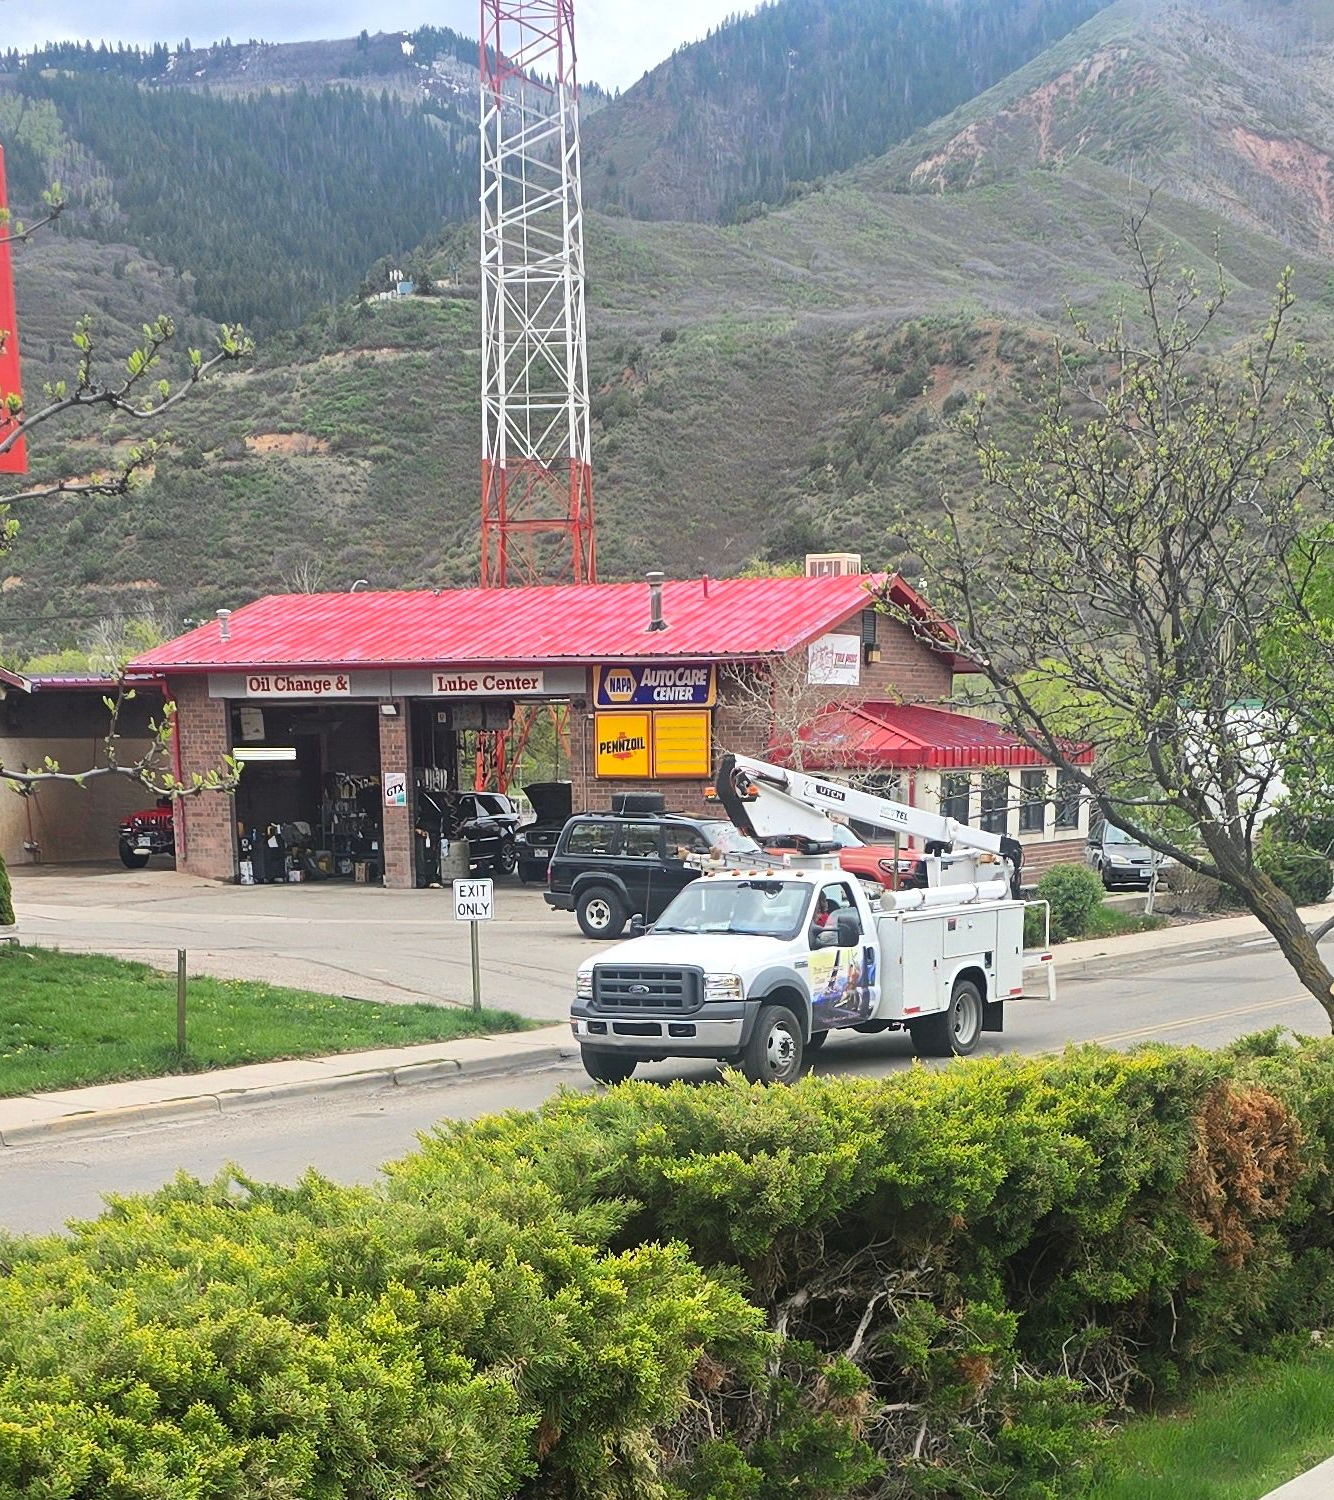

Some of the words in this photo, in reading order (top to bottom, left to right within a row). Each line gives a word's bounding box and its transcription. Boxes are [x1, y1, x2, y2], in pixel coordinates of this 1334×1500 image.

[249, 677, 270, 692] Oil
[274, 677, 331, 694] Change
[336, 675, 347, 690] &
[437, 676, 478, 691] Lube
[483, 675, 538, 690] Center
[610, 677, 632, 692] NAPA
[653, 687, 693, 701] CENTER
[600, 737, 645, 755] PENNZOIL
[387, 783, 404, 796] GTX
[460, 885, 487, 897] EXIT
[458, 903, 489, 915] ONLY
